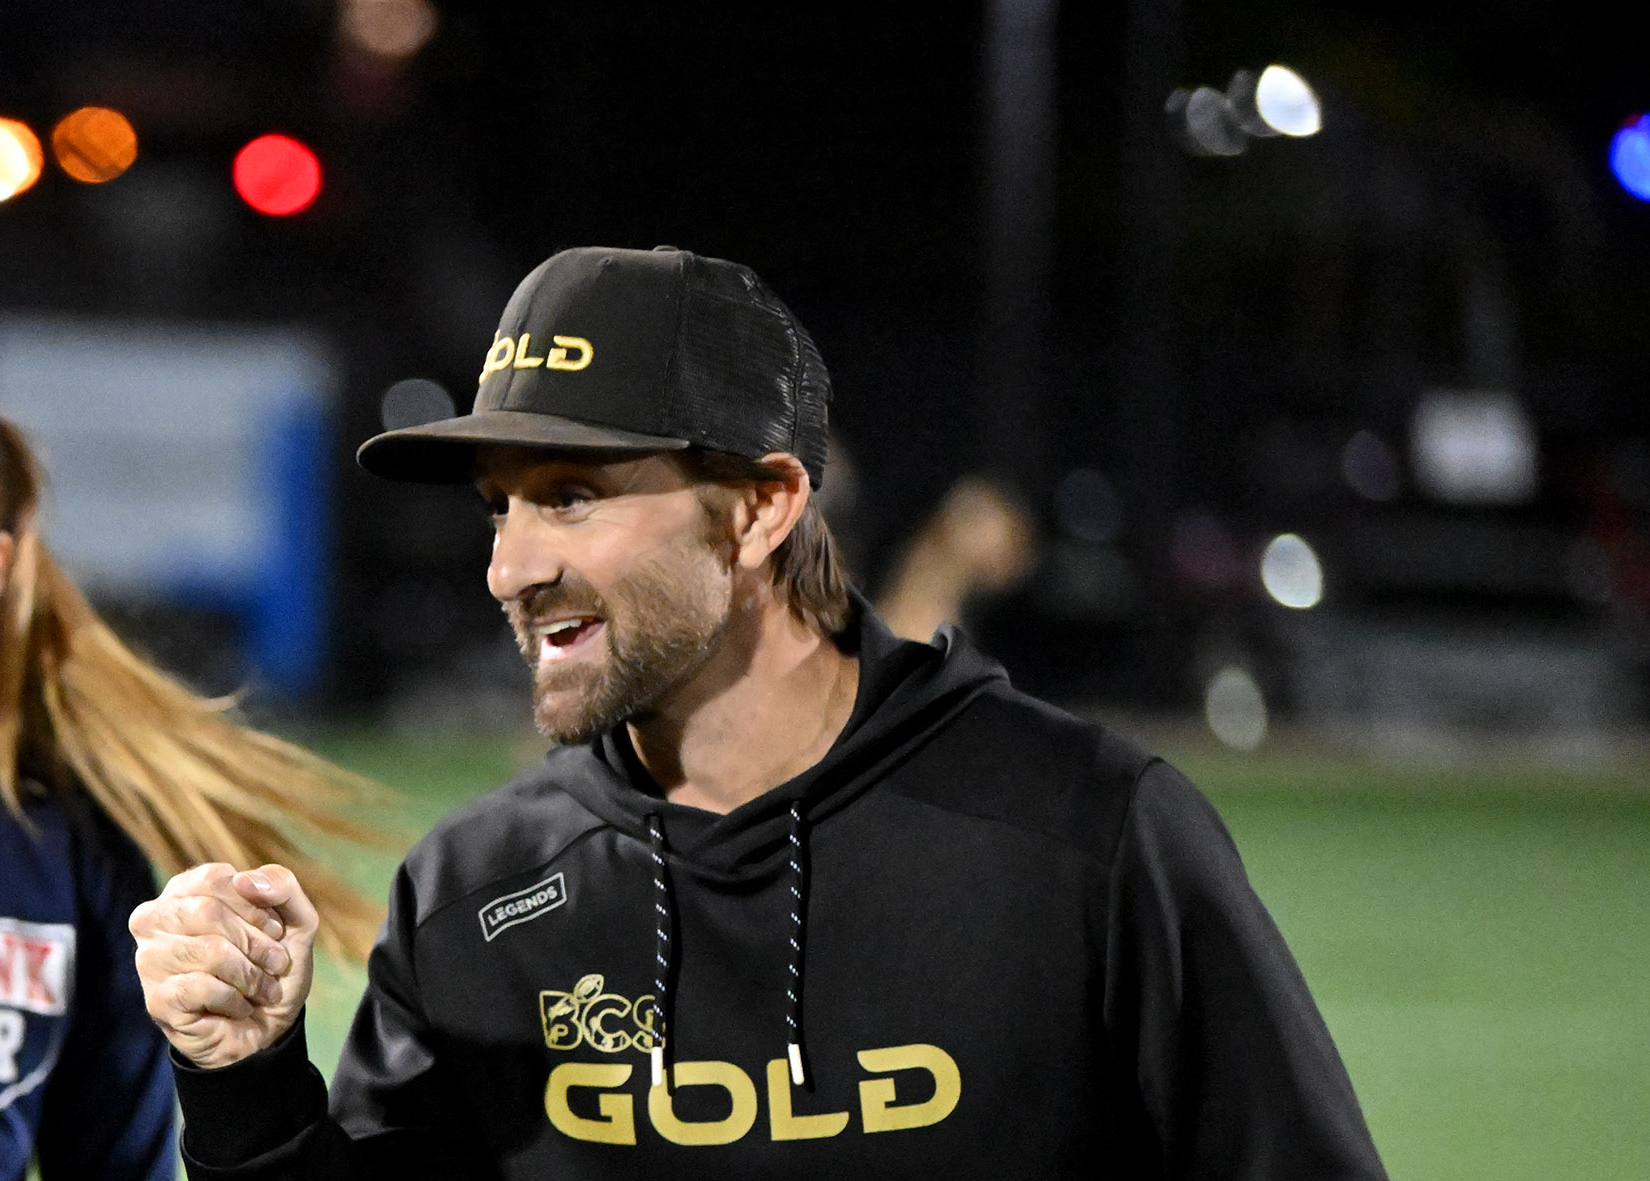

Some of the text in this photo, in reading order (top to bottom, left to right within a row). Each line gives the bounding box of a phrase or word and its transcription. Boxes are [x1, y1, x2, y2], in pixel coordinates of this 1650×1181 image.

[479, 329, 594, 384] OLD
[488, 886, 558, 927] LEGENDS
[545, 1044, 962, 1146] GOLD
